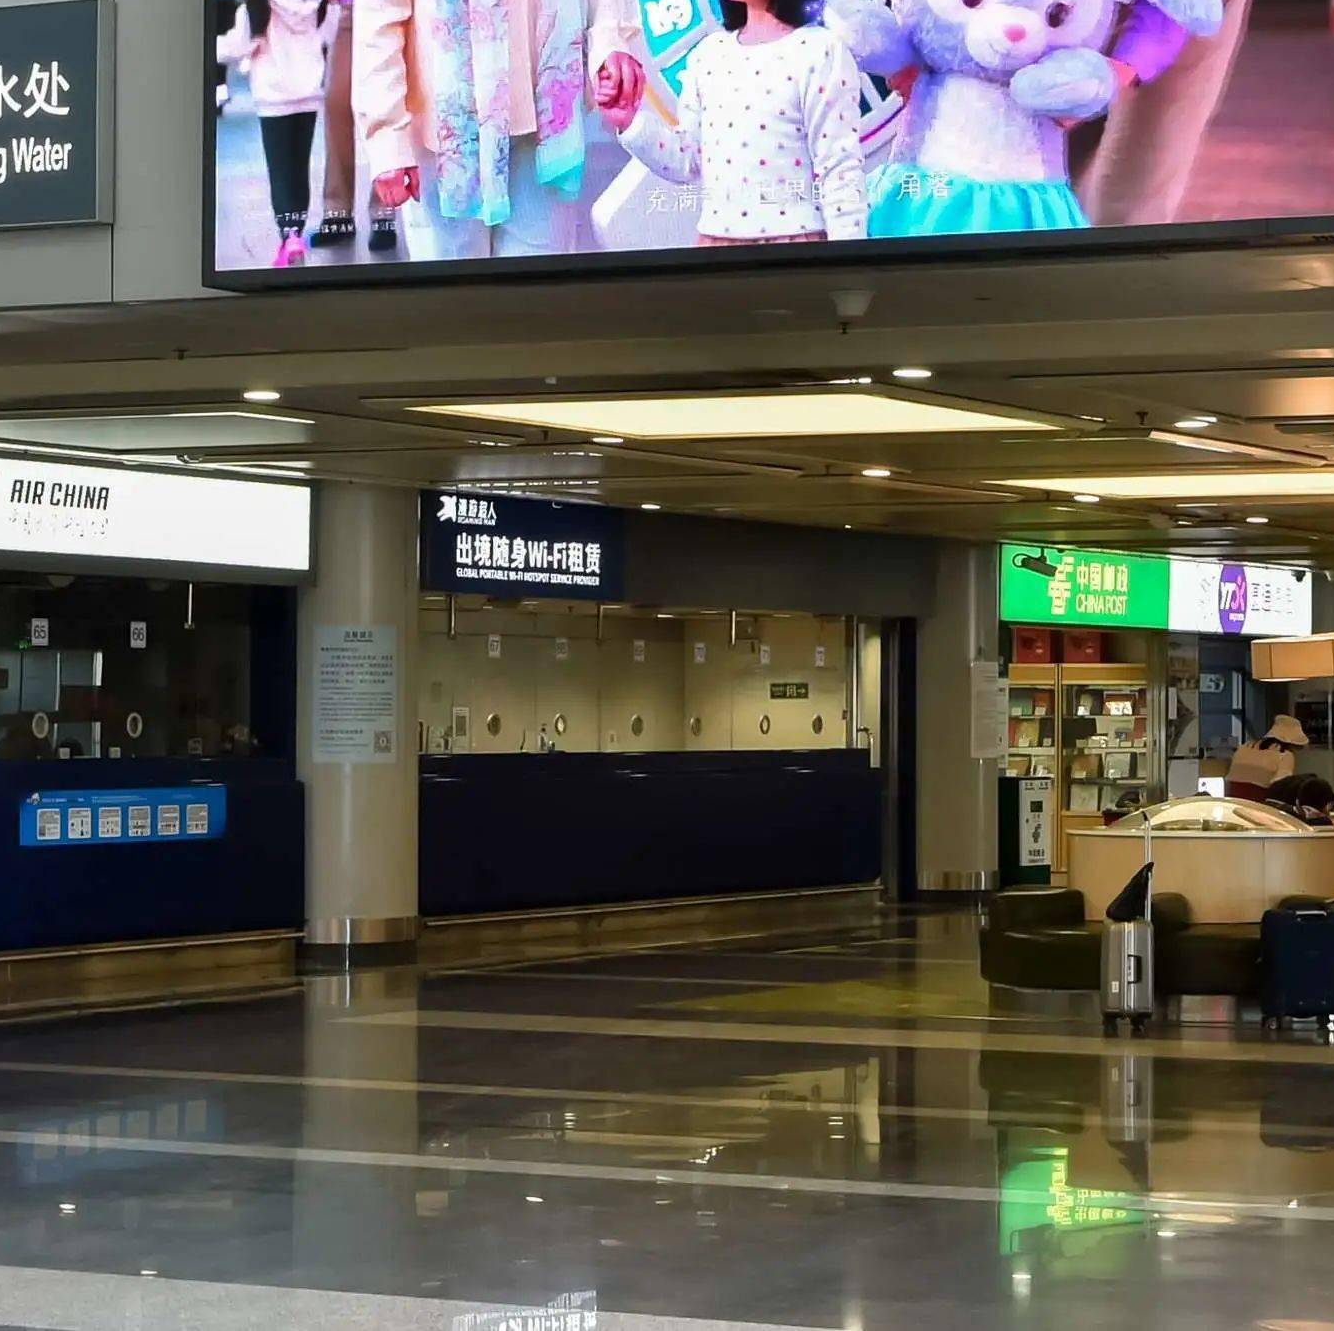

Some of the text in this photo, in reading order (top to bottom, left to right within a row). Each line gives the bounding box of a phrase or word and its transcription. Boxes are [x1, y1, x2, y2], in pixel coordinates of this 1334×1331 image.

[11, 137, 73, 173] Water
[10, 479, 110, 511] AIR CHINA
[455, 531, 602, 574] 出境随身Wi-Fi租赁
[456, 567, 478, 579] GLOBAL
[479, 568, 508, 581] PORTABLE
[524, 572, 550, 584] HOTSPOT
[1075, 558, 1128, 593] 中国邮政
[1075, 592, 1128, 617] CHINA POST
[33, 625, 46, 639] 65
